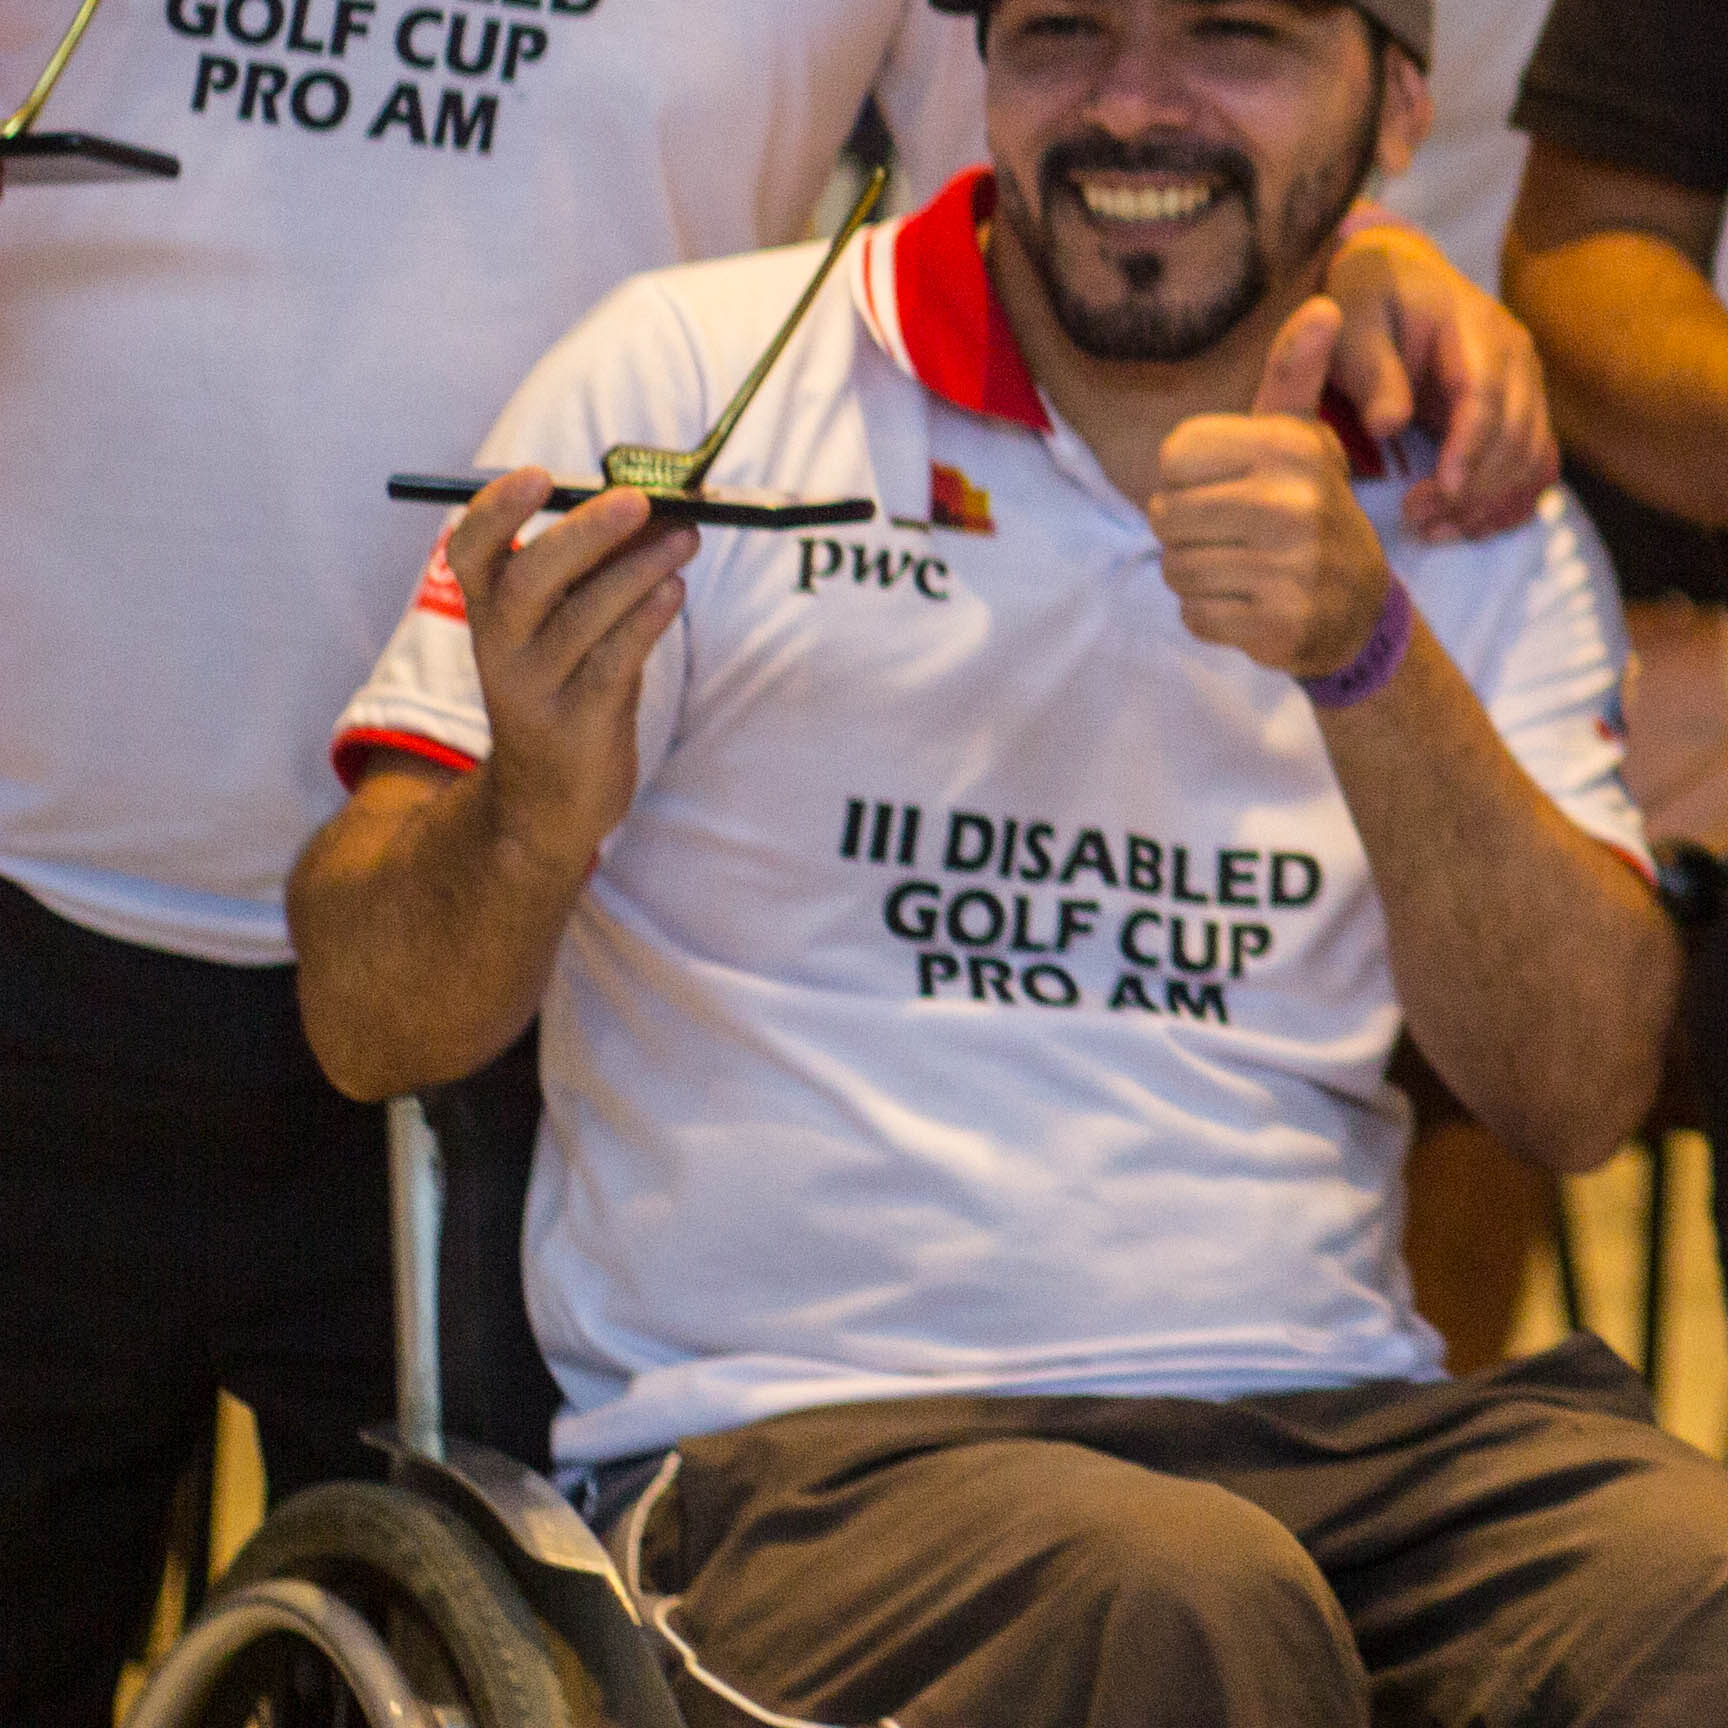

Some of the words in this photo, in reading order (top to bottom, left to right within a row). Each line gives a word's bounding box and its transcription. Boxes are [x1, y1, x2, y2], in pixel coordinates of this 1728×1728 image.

[394, 6, 549, 84] CUP
[190, 53, 353, 134] PRO
[367, 81, 501, 156] AM
[791, 536, 949, 603] pwc
[839, 797, 923, 868] III
[943, 811, 1324, 912] DISABLED
[883, 878, 1102, 957] GOLF
[1119, 908, 1274, 980] CUP
[917, 948, 1082, 1010] PRO
[1109, 970, 1229, 1025] AM
